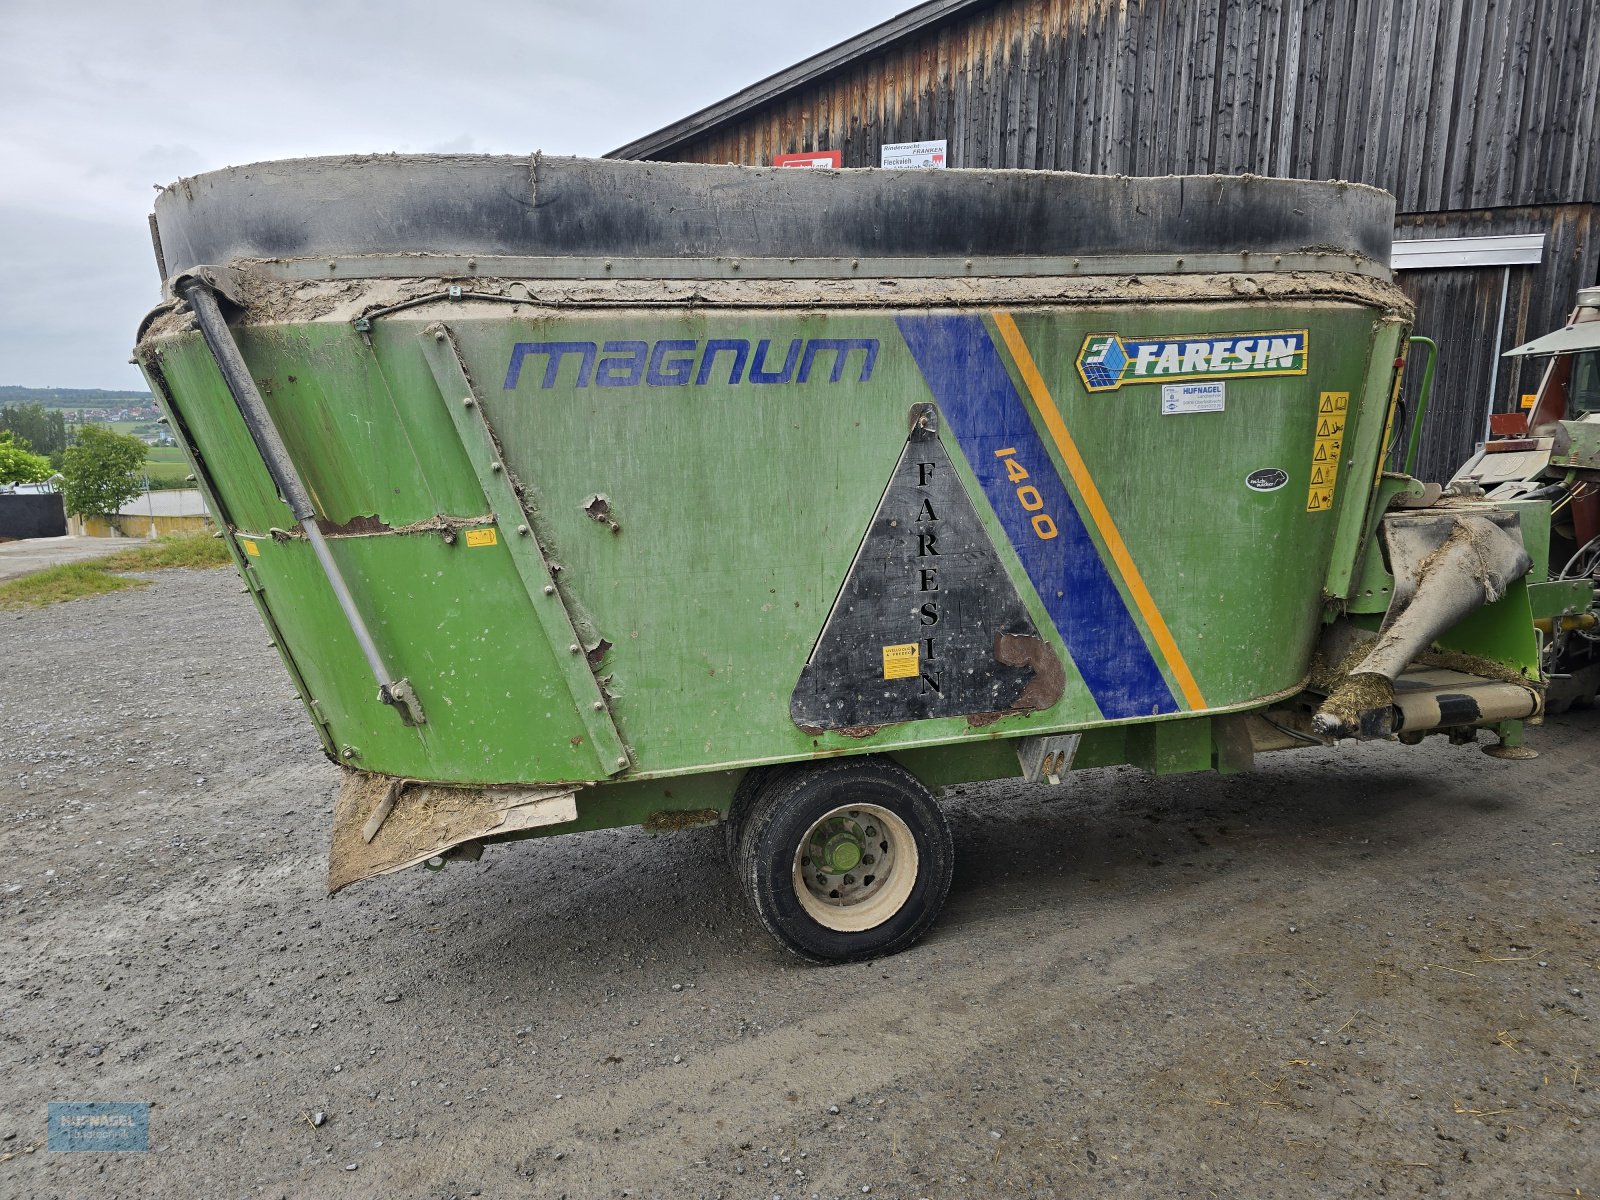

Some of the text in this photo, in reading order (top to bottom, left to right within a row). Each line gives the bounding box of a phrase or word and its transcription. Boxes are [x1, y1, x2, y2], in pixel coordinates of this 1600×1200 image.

[1134, 337, 1297, 376] FARESIN
[1183, 386, 1221, 394] HUFNAGEL
[994, 447, 1059, 540] 1400
[915, 461, 942, 696] FARESIN
